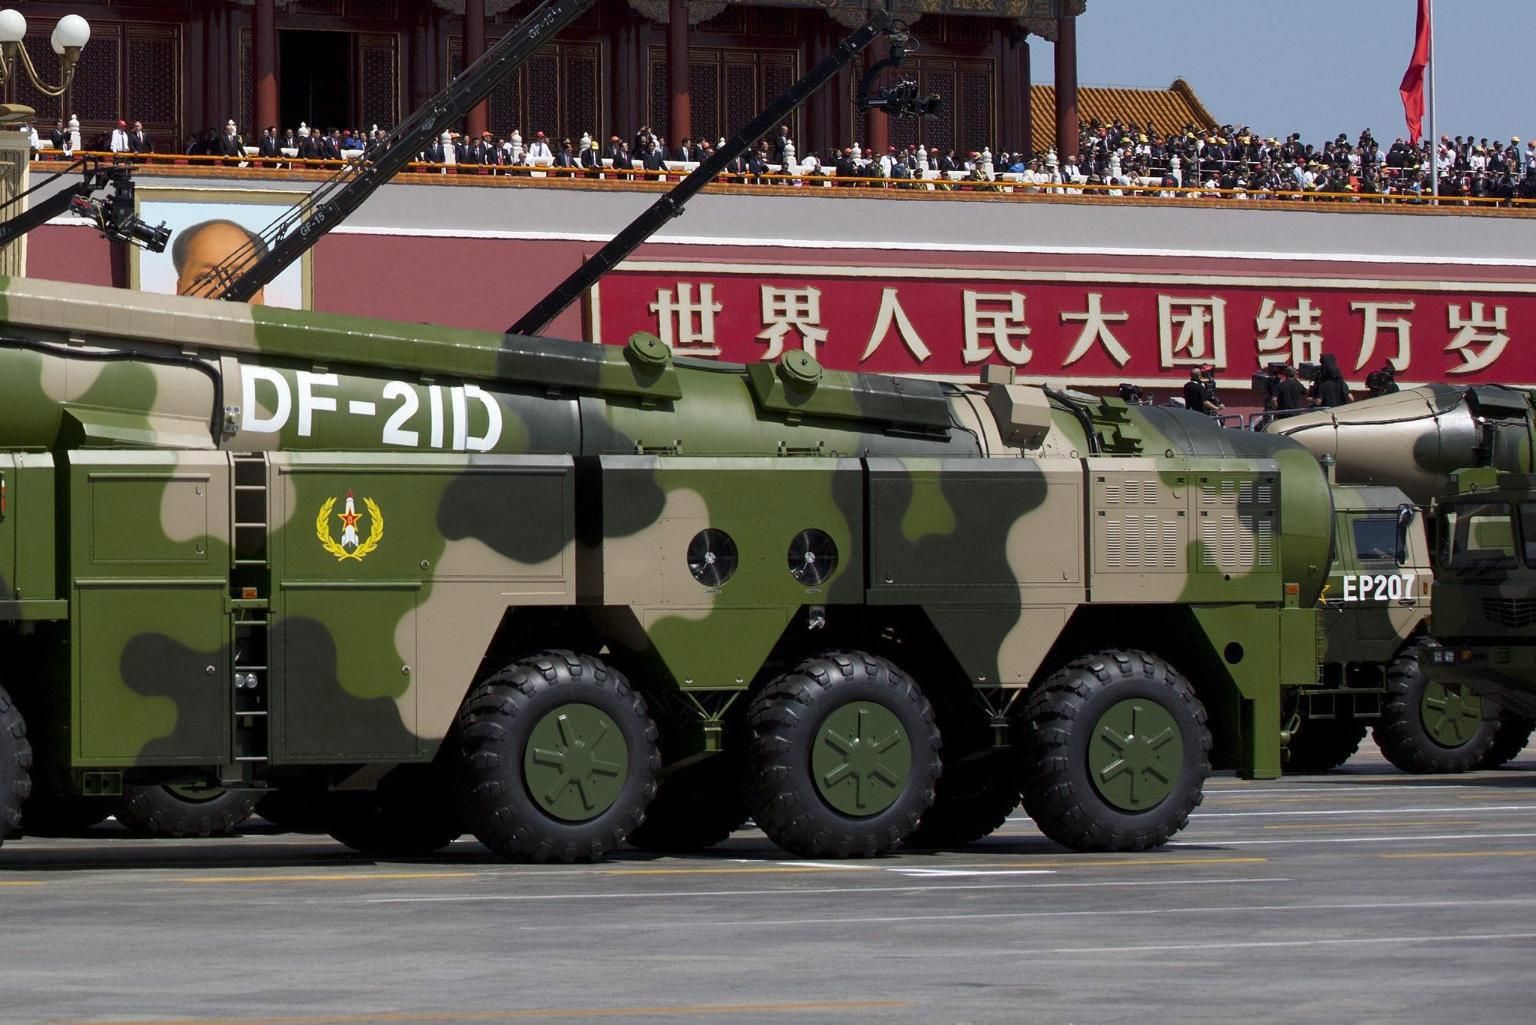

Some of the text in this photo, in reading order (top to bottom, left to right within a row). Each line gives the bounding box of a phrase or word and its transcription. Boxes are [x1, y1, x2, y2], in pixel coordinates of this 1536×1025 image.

[300, 211, 325, 236] GF-15
[648, 281, 1511, 375] 世界人民大团结万岁
[240, 364, 503, 453] DF-21D
[1343, 574, 1415, 602] EP207
